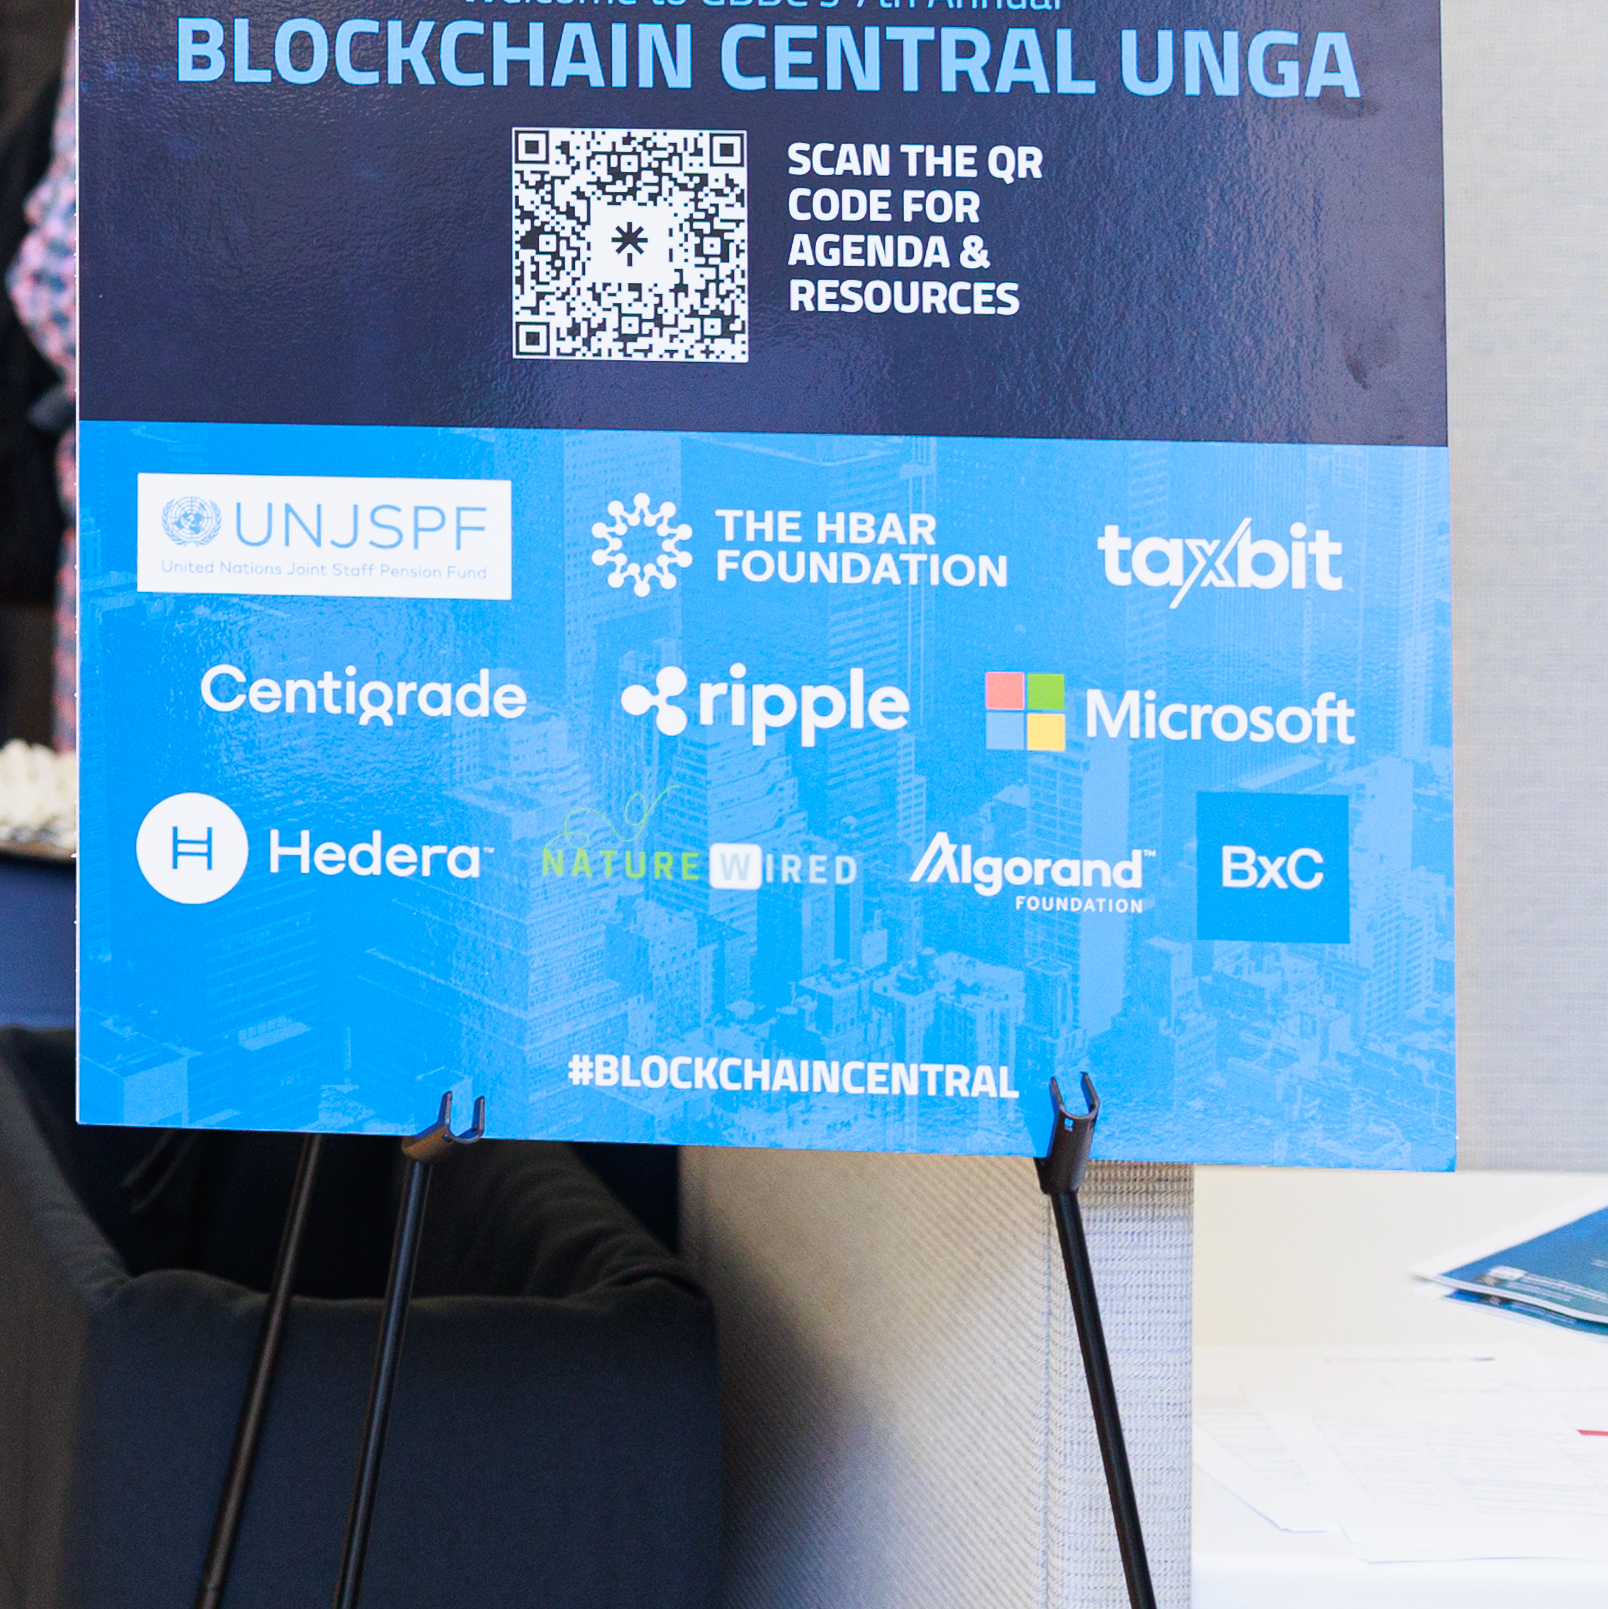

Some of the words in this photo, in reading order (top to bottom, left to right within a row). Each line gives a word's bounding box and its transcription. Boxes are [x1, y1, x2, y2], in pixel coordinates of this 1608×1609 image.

[176, 14, 694, 91] BLOCKCHAIN
[719, 21, 1097, 96] CENTRAL
[1117, 27, 1363, 99] UNGA
[787, 141, 891, 177] SCAN
[899, 143, 978, 178] THE
[986, 144, 1044, 185] QR
[787, 187, 893, 222] CODE
[902, 189, 981, 224] FOR
[787, 233, 951, 269] AGENDA
[958, 234, 992, 270] &
[789, 278, 1021, 316] RESOURCES
[234, 500, 487, 552] UNJSPF
[714, 508, 802, 543] THE
[816, 511, 937, 546] HBAR
[160, 558, 215, 575] United
[219, 560, 283, 576] Nations
[286, 561, 328, 577] Joint
[331, 562, 376, 578] Staff
[380, 563, 442, 579] Pension
[446, 564, 488, 580] Fund
[716, 548, 1008, 588] FOUNDATION
[1096, 516, 1344, 610] taxbit
[199, 663, 529, 727] Centigrade
[698, 661, 911, 748] ripple
[1084, 688, 1356, 746] Microsoft
[541, 849, 700, 881] NATURE
[719, 852, 858, 885] WIRED
[1221, 844, 1325, 891] BxC
[1014, 894, 1144, 915] FOUNDATION
[566, 1051, 1021, 1100] #BLOCKCHAINCENTRAL
